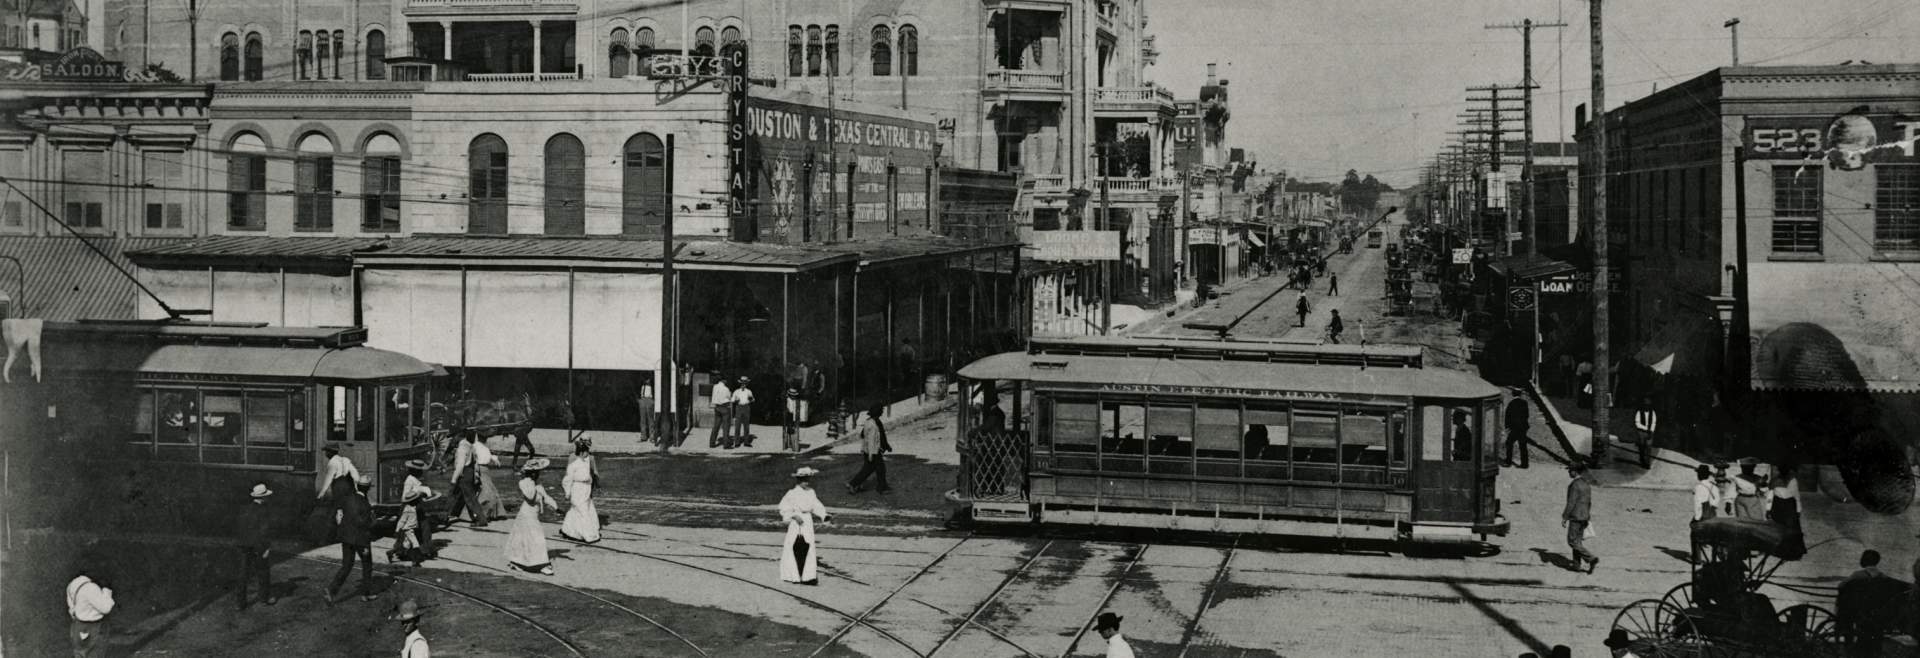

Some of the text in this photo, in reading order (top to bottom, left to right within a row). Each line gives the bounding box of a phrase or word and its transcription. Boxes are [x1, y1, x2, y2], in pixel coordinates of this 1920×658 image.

[731, 51, 743, 214] CRYSTAL
[747, 107, 802, 141] OUSTON
[809, 116, 818, 142] &
[824, 117, 861, 145] TEXAS
[866, 123, 911, 148] CENTRAL
[1753, 128, 1822, 152] 523
[1540, 280, 1573, 293] LOAN
[1101, 383, 1161, 394] AUSTIN
[1170, 385, 1250, 397] ELECTRIC
